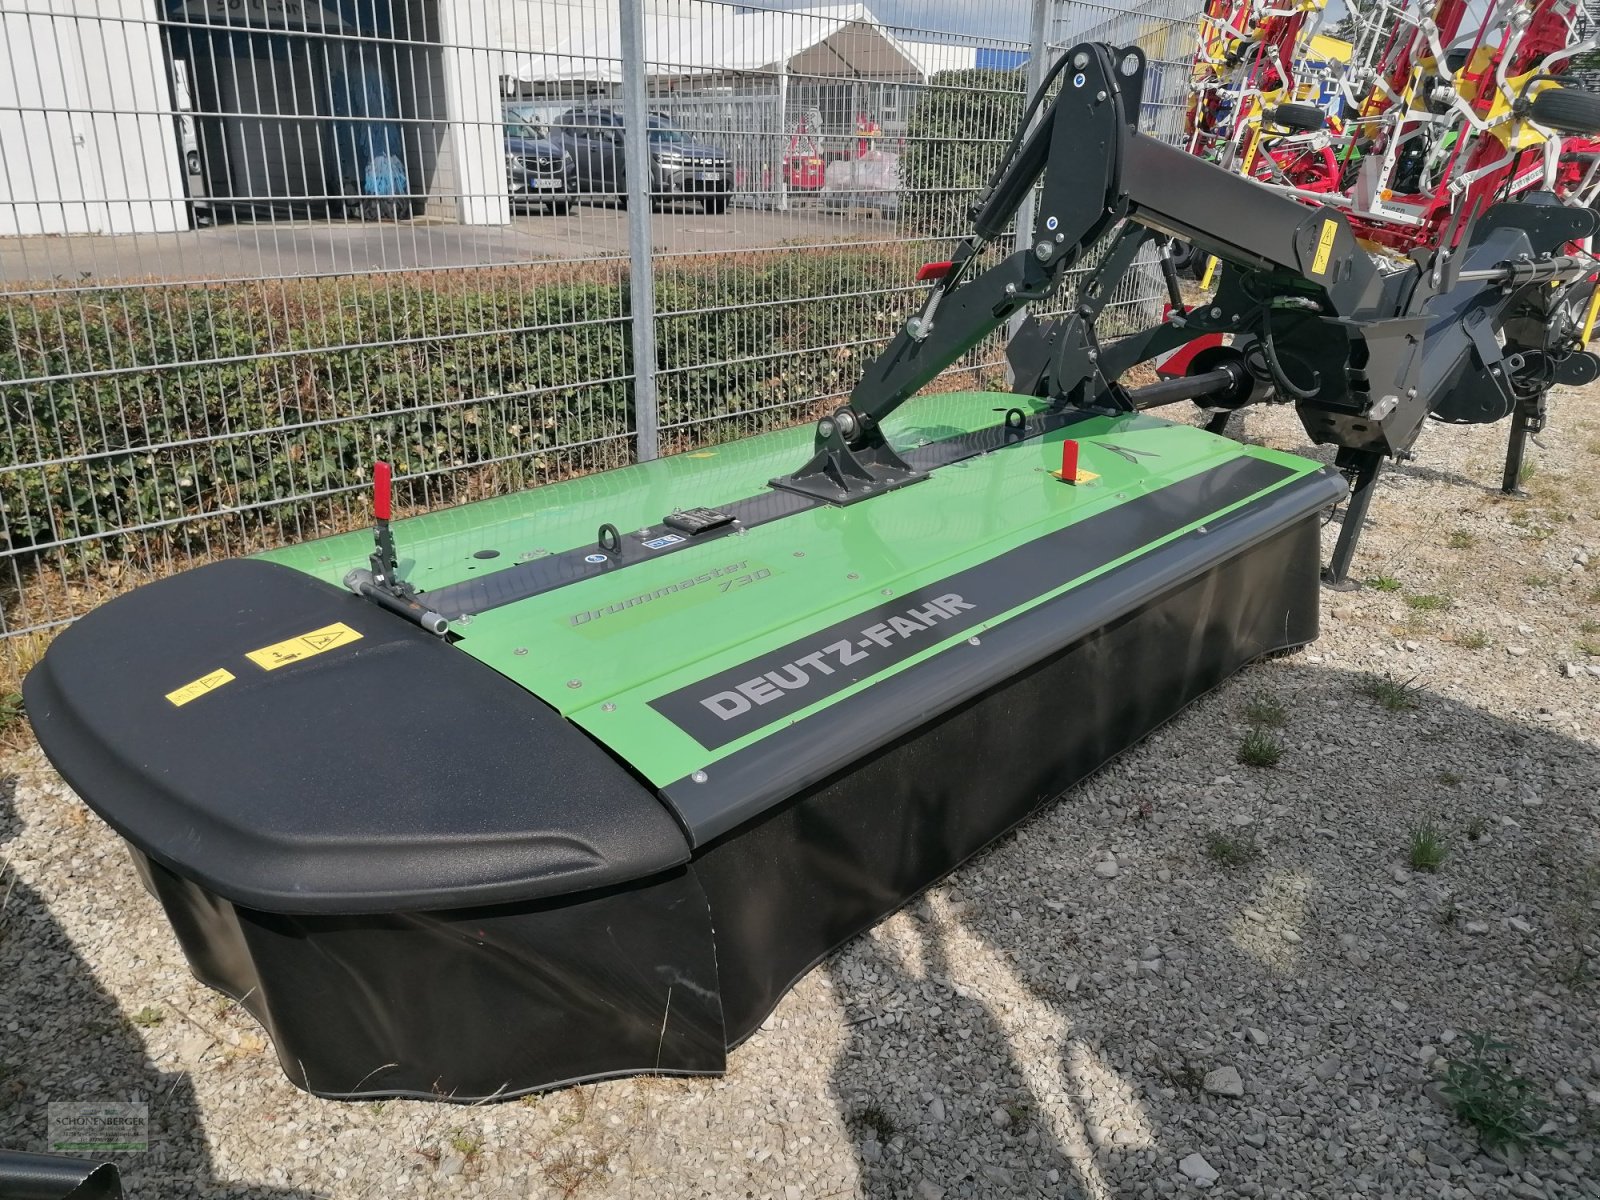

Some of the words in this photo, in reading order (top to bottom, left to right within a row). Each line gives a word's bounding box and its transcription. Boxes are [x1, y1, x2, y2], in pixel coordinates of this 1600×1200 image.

[570, 560, 749, 627] Drummaster
[718, 568, 772, 593] 730
[699, 592, 977, 721] DEUTZ-FAHR
